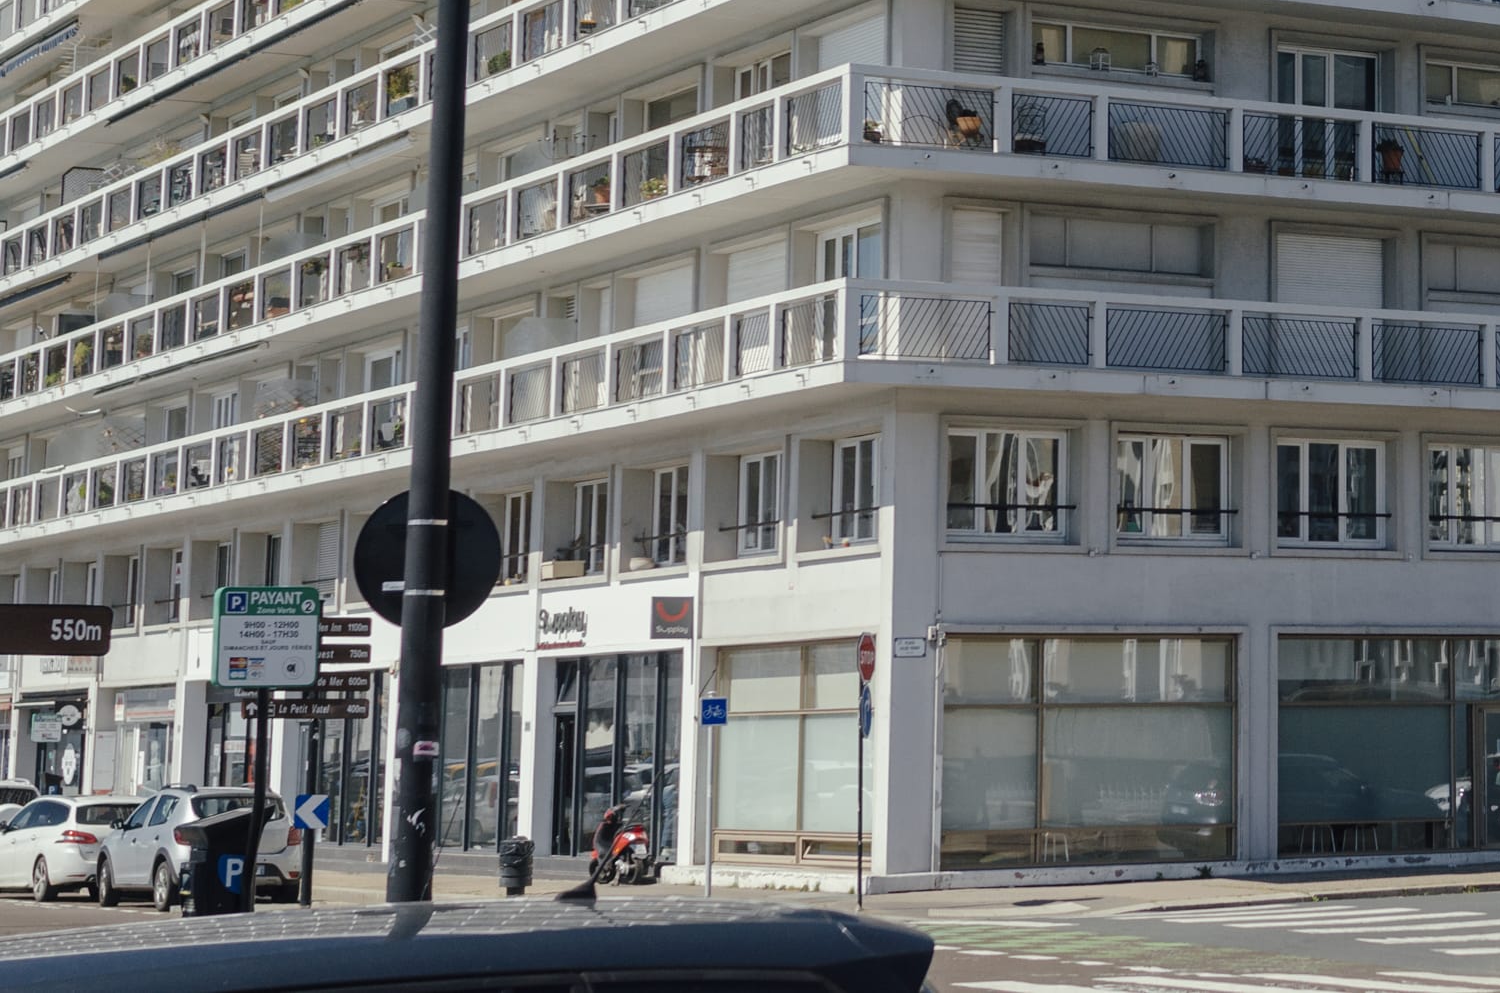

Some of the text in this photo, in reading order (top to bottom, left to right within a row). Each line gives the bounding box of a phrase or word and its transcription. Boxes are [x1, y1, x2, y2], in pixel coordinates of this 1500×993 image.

[231, 596, 242, 610] P
[250, 591, 303, 605] PAYANT
[304, 601, 313, 612] 2
[50, 618, 102, 641] 550m
[243, 621, 266, 629] 9H00
[273, 621, 300, 629] 12H00
[655, 625, 689, 635] Supplay
[239, 630, 266, 638] 14H00
[273, 630, 300, 638] 17H30
[860, 651, 874, 665] STOP
[329, 677, 344, 686] Mer
[347, 677, 368, 686] 600m
[278, 704, 288, 714] Le
[290, 704, 308, 714] Petit
[225, 858, 244, 888] P
